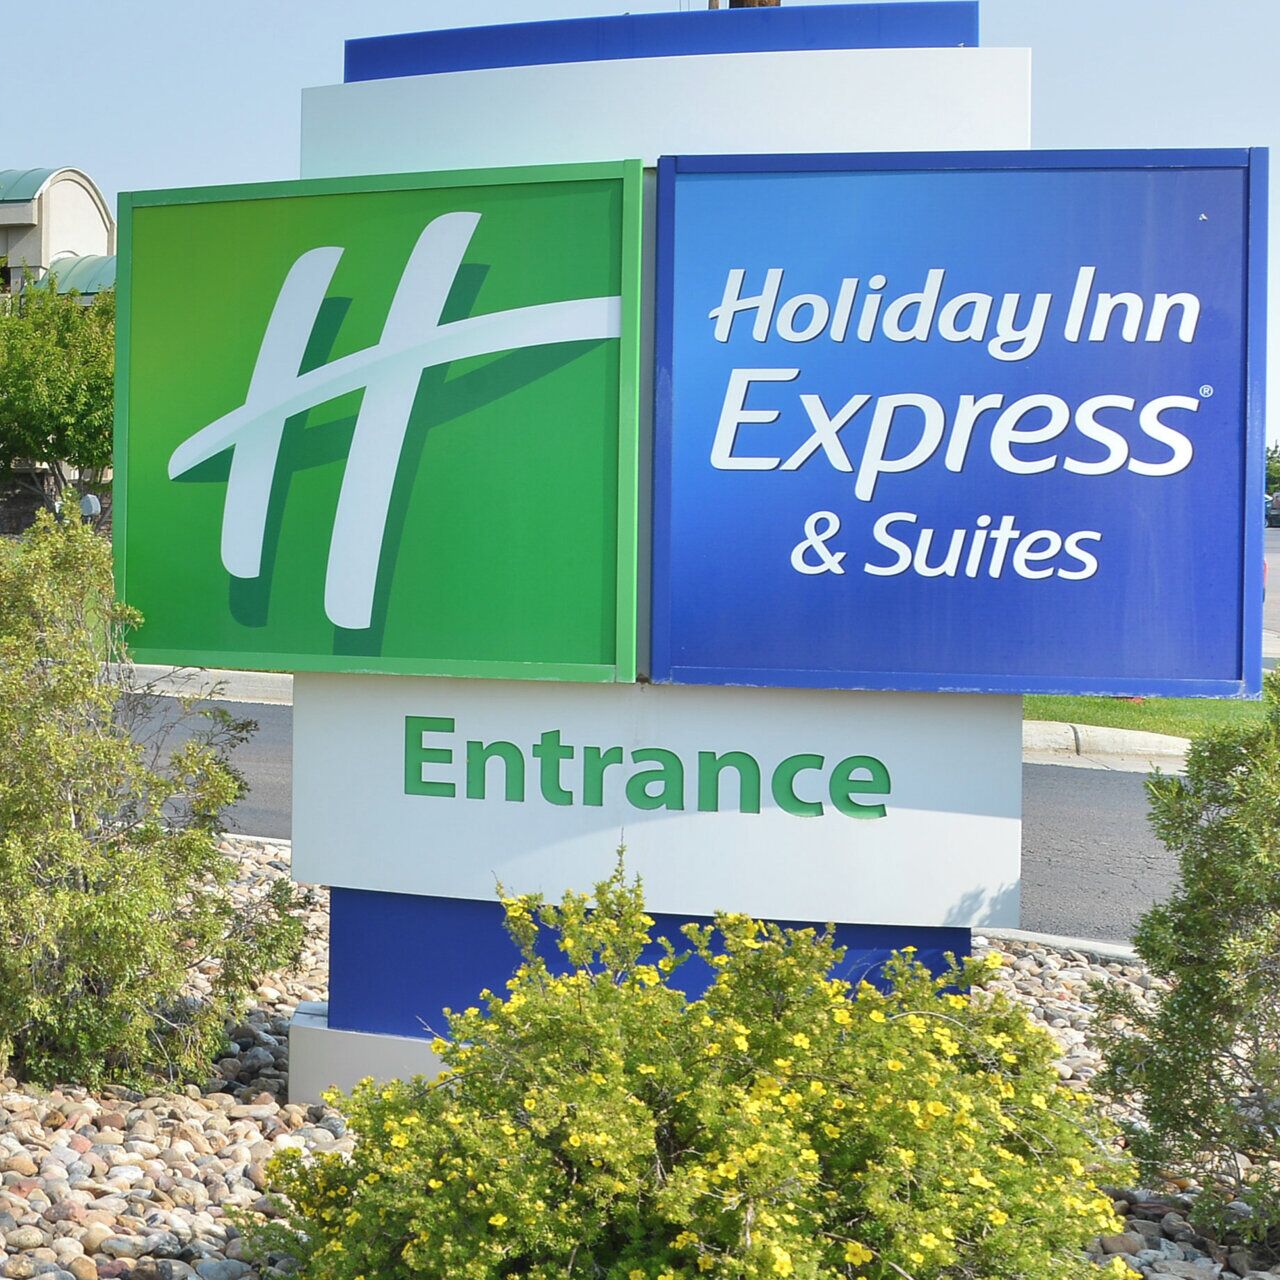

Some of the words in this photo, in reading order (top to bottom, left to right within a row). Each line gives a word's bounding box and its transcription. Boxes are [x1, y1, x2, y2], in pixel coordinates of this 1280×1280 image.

[708, 267, 1052, 361] Holiday
[1064, 265, 1201, 344] Inn
[790, 510, 848, 576] &
[863, 511, 1102, 581] Suites
[403, 715, 892, 820] Entrance
